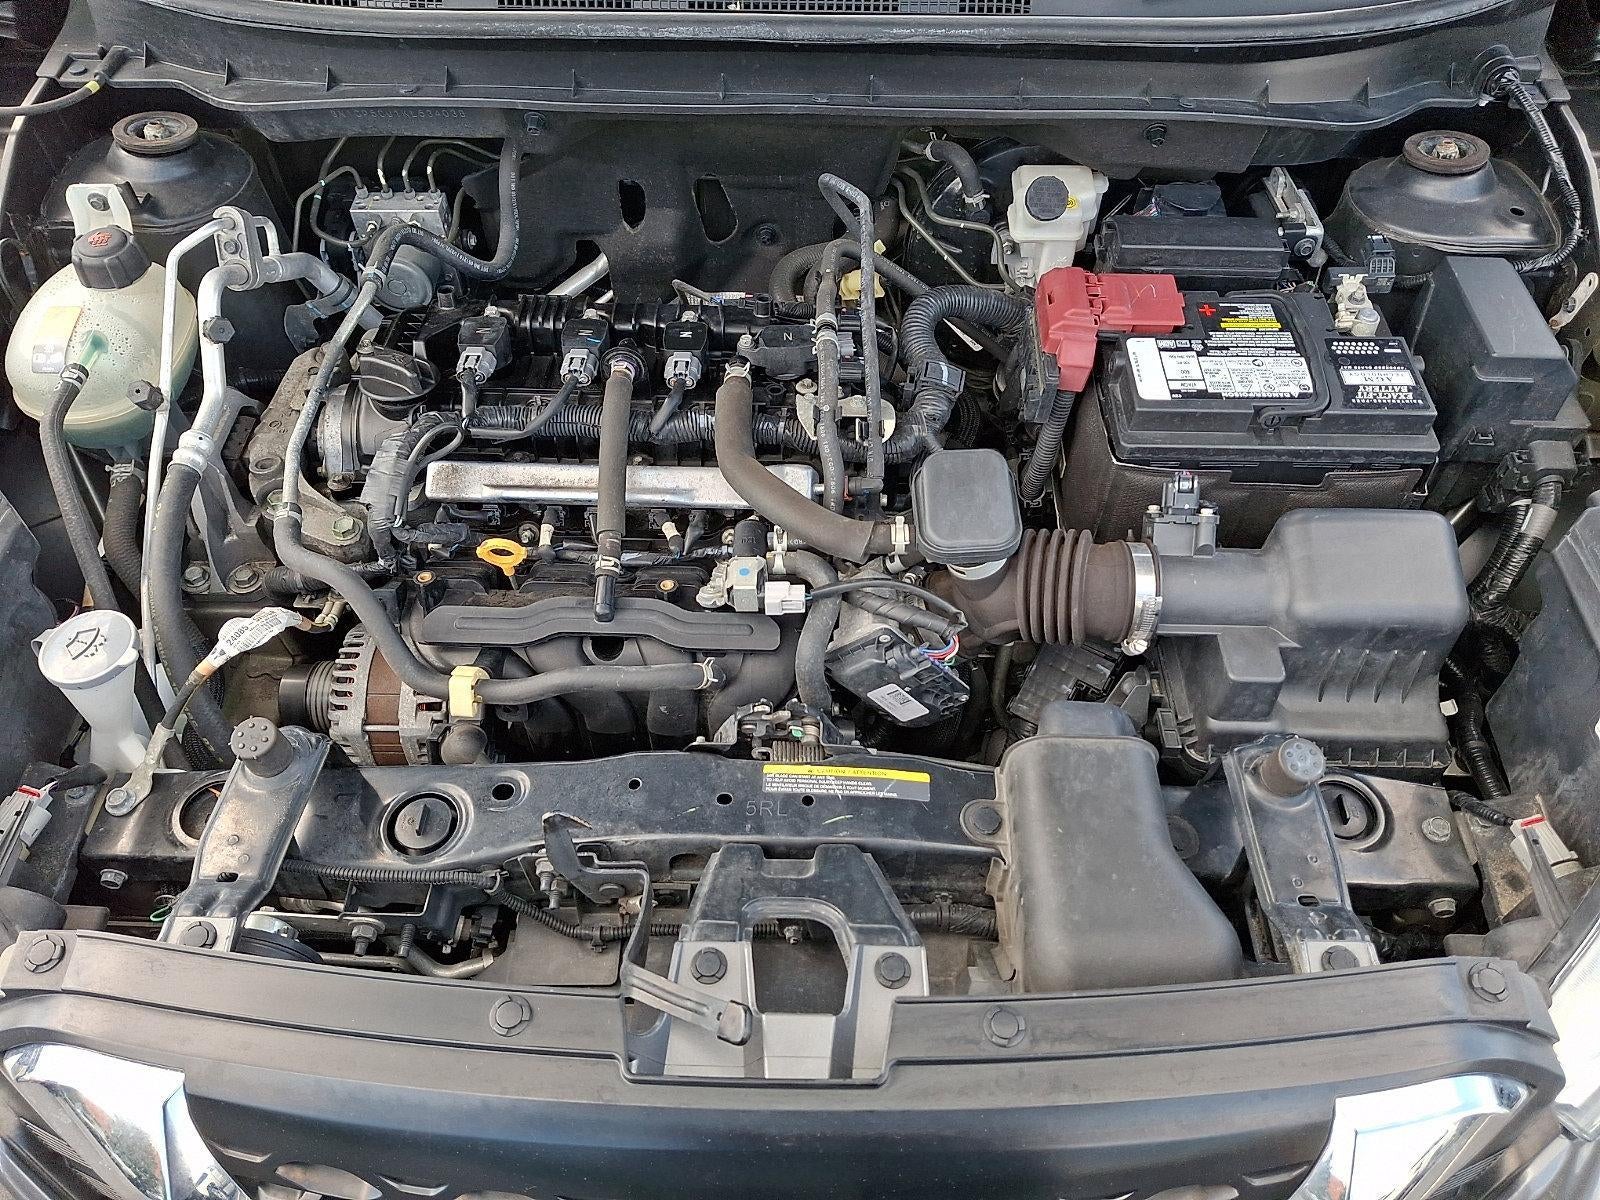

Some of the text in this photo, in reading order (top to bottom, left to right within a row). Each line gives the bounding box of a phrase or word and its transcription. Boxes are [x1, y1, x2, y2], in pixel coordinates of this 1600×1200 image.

[783, 332, 793, 340] N
[1358, 385, 1408, 393] BATTERY
[1355, 391, 1414, 400] EXACT-FIT
[746, 800, 788, 816] 5RL
